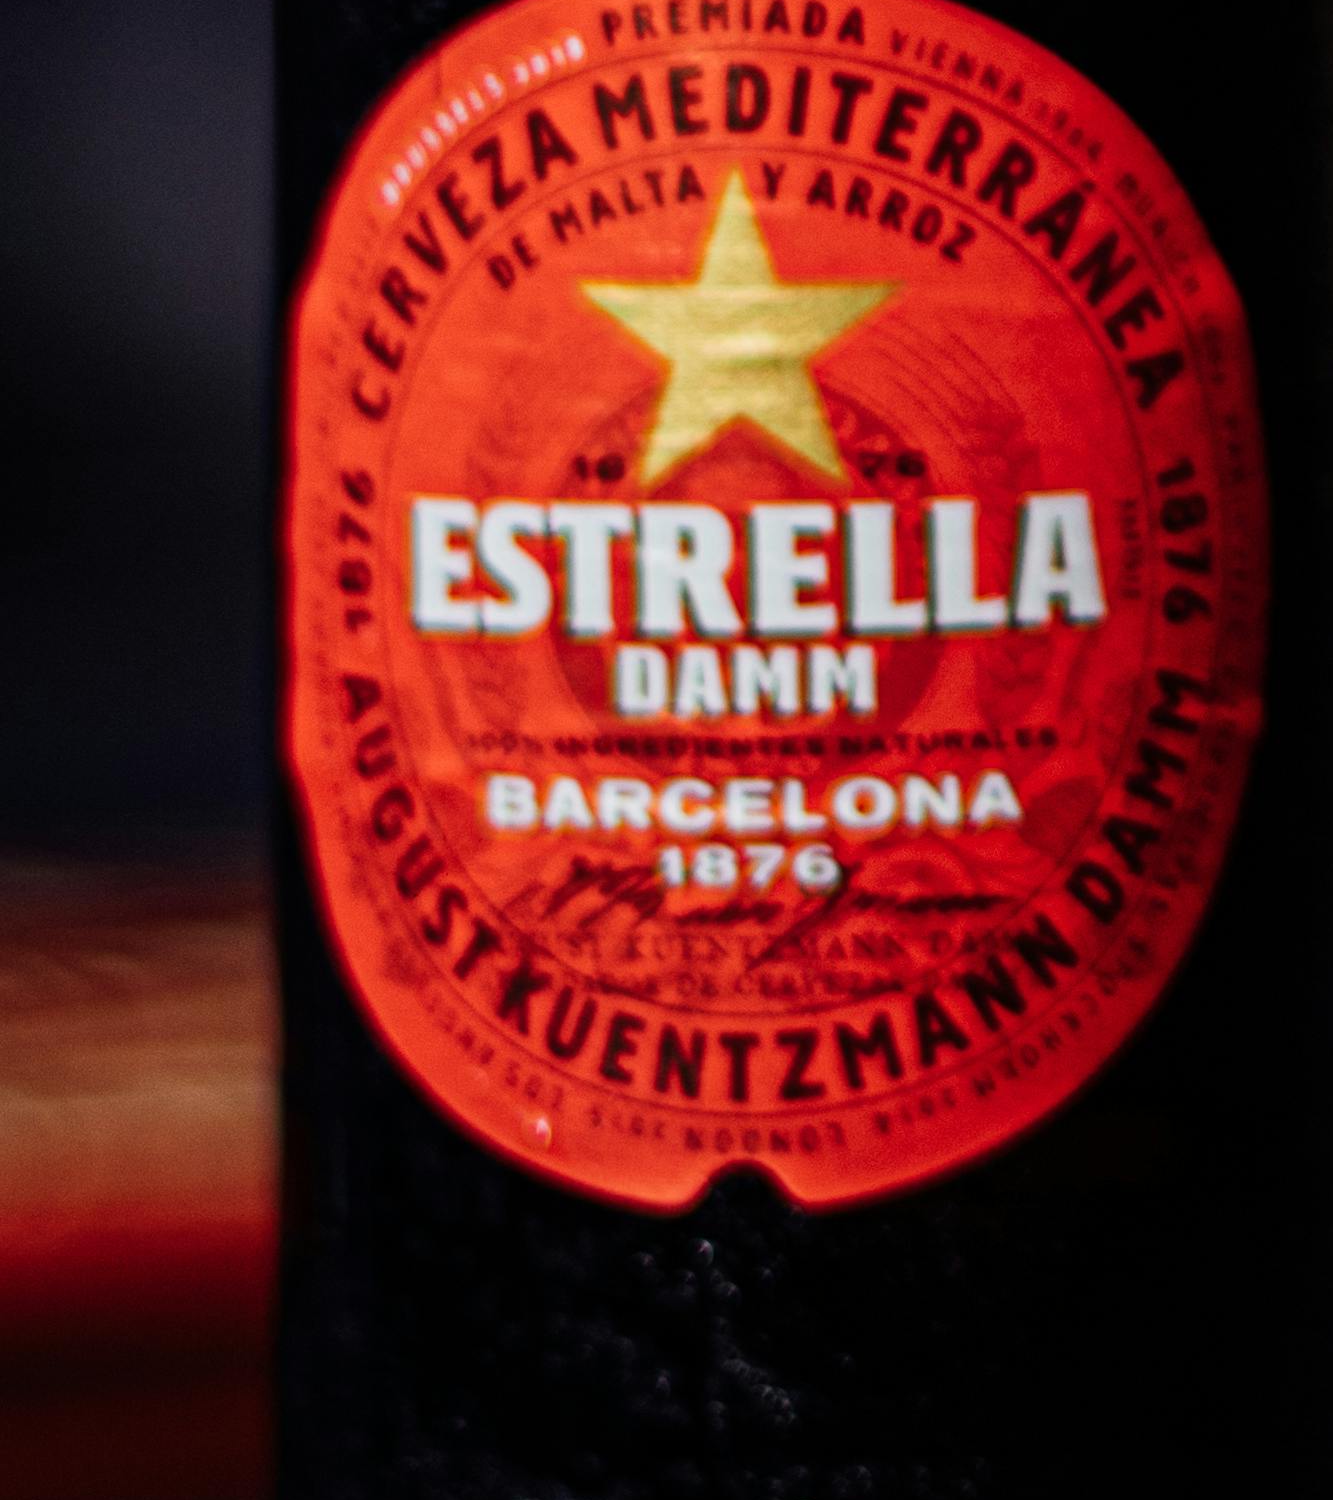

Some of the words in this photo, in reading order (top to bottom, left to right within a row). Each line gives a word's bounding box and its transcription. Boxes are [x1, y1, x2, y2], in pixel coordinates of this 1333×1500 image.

[350, 107, 578, 422] CERVEZA
[592, 62, 1185, 409] MEDITERRÁNEA
[486, 232, 539, 292] DE
[548, 165, 706, 246] MALTA
[761, 161, 786, 200] Y
[806, 168, 977, 265] ARROZ
[410, 490, 1108, 637] ESTRELLA
[1158, 456, 1215, 628] 1876
[613, 643, 878, 720] DAMM
[485, 770, 1024, 834] BARCELONA
[342, 672, 501, 981] AUGUST
[498, 912, 1080, 1103] KUENTZMANN
[1066, 666, 1204, 925] DAMM
[659, 843, 842, 891] 1876
